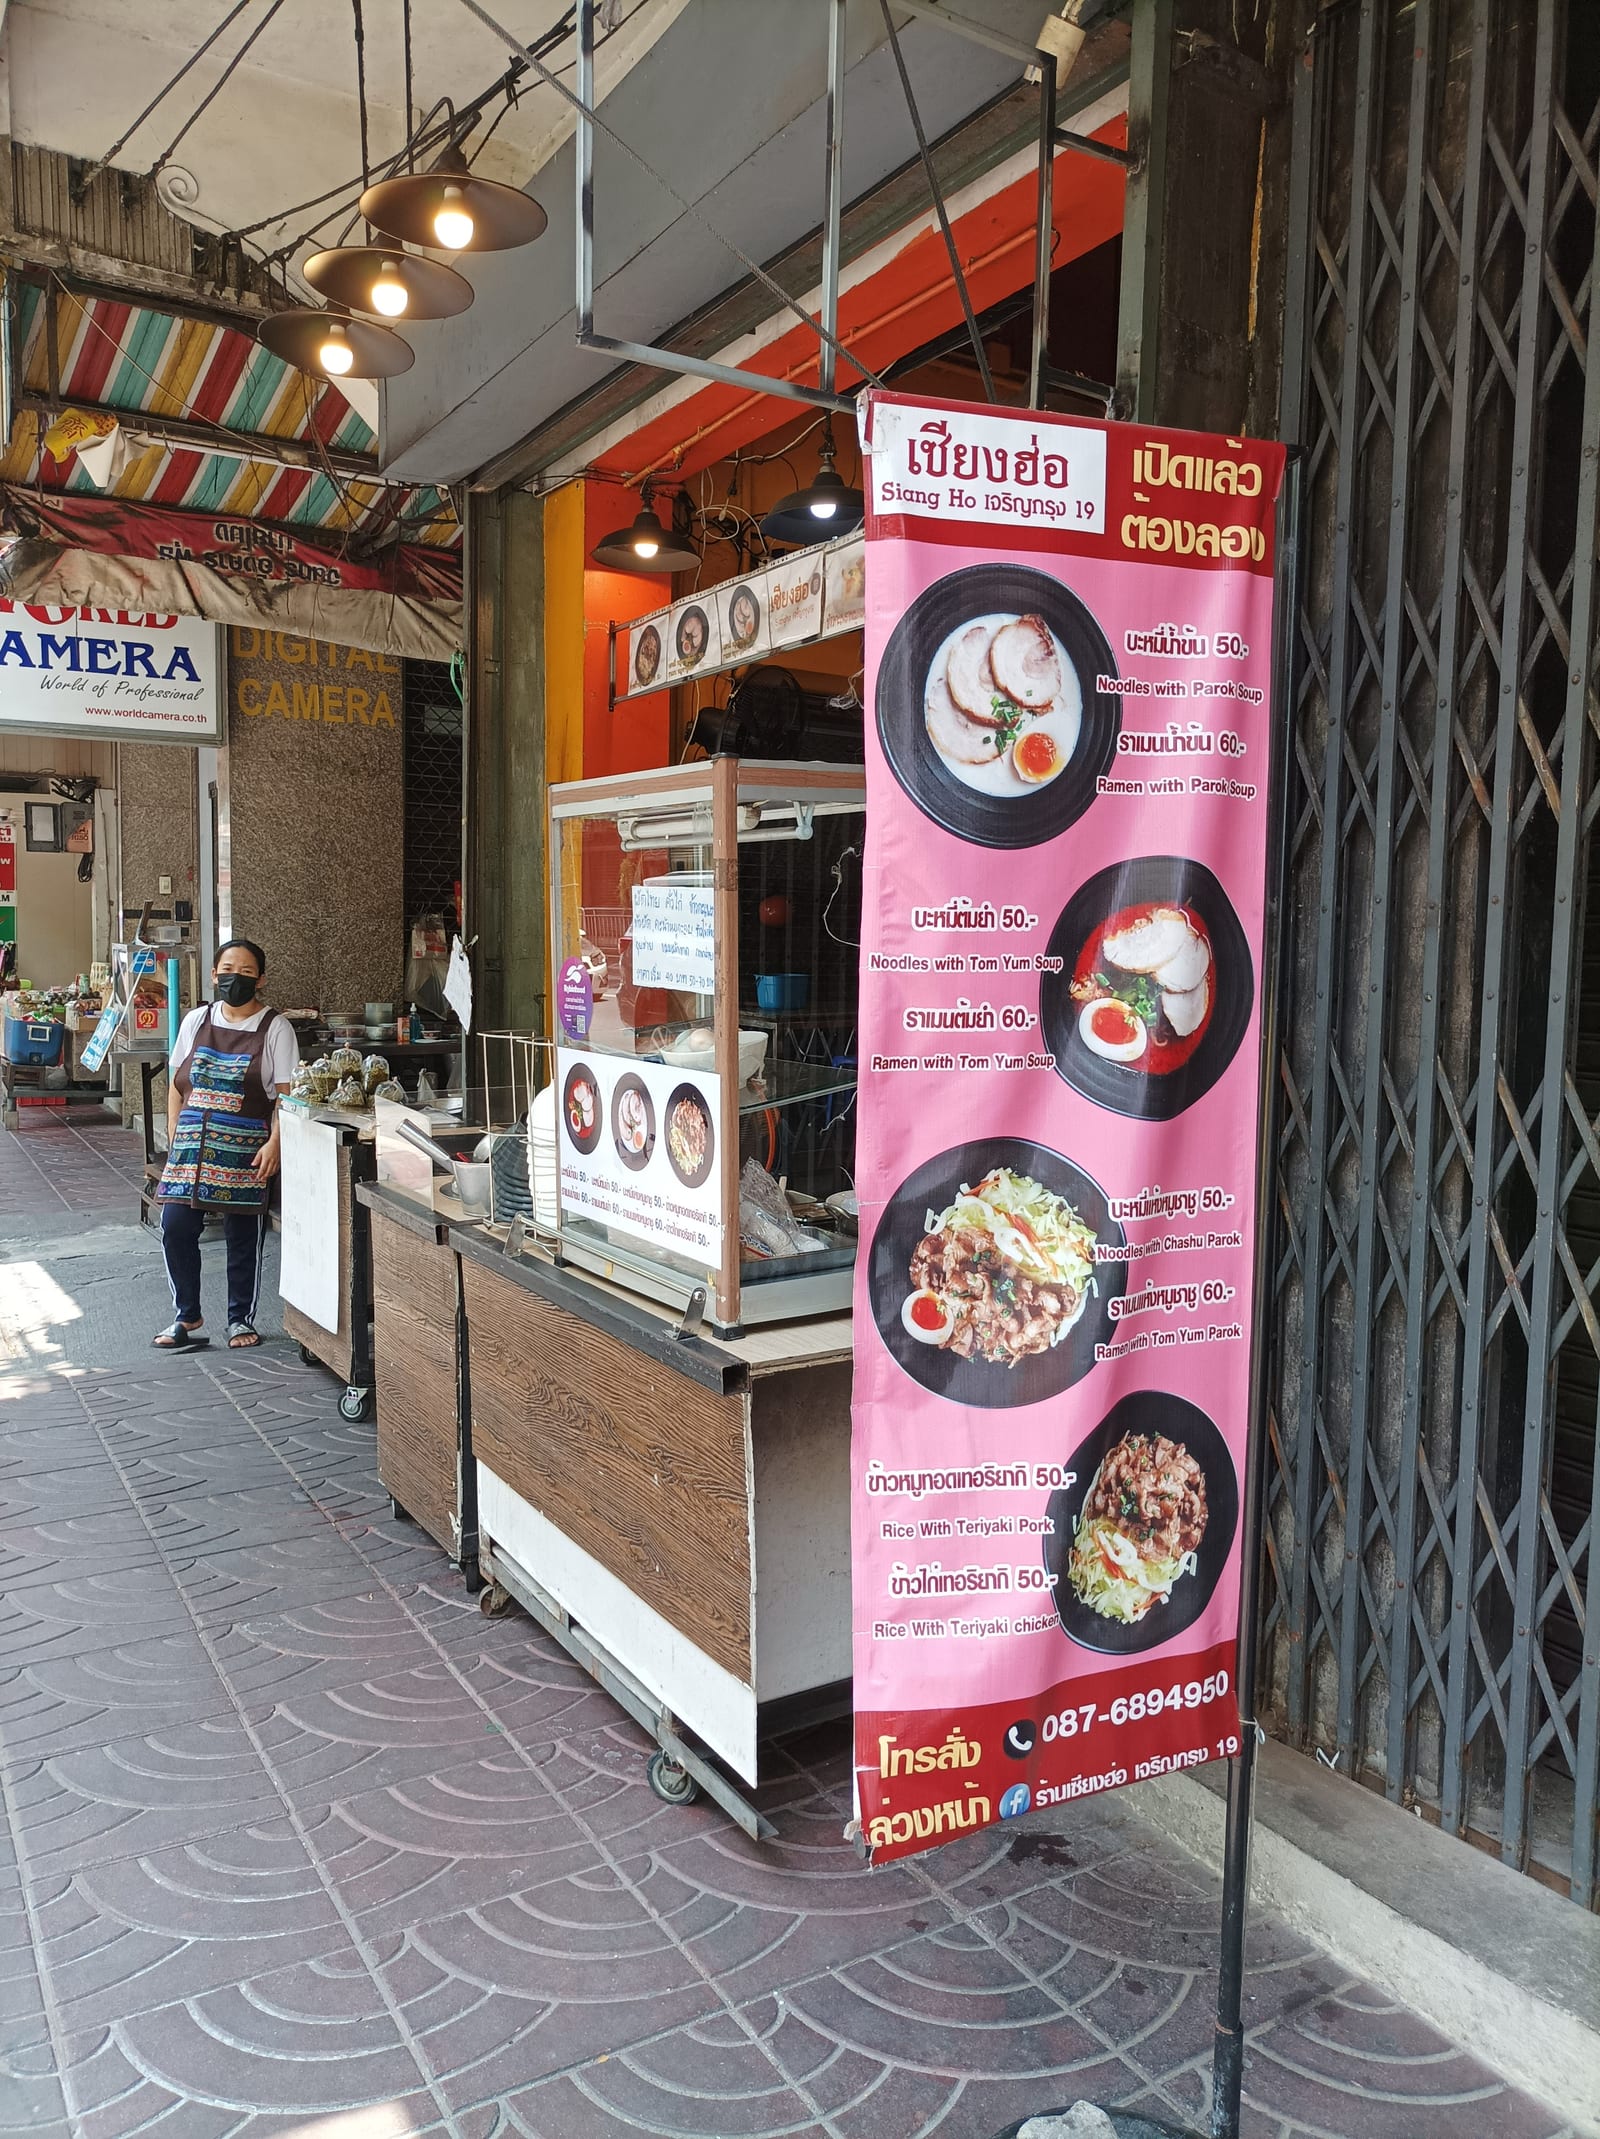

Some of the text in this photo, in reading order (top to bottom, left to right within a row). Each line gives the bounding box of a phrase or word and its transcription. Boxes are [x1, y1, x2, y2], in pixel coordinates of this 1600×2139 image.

[907, 420, 1069, 489] เซียงฮ่อ
[1133, 438, 1262, 497] เปิดแล้ว
[881, 481, 1095, 521] Siang Ho เจริญกรุง 19
[1121, 492, 1265, 562] ต้องลอง
[1127, 625, 1248, 657] บะหมี่น้ำข้น 50.-
[40, 674, 205, 702] World of Professional
[237, 678, 395, 728] CAMERA
[1097, 677, 1263, 704] Noodles with Parok Soup
[85, 706, 207, 724] www.worldcamera.co.th
[1119, 725, 1245, 755] ราเมนน้ำข้น 60.-
[1097, 777, 1255, 799] Ramen with Parok Soup
[914, 900, 1036, 928] บะหมี่ต้มยำ 50.-
[870, 955, 1062, 972] Noodles with Tom Yum Soup
[906, 1000, 1035, 1029] ราเมนต้มยำ 60.-
[872, 1053, 1054, 1070] Ramen with Tom Yum Soup
[1202, 1189, 1233, 1208] 50.-
[1097, 1232, 1240, 1260] Noodles with Chashu Parok
[1203, 1282, 1233, 1300] 60.-
[1096, 1324, 1240, 1359] Ramen with Tom Yum Parok
[868, 1463, 1074, 1498] ข้าวหมูทอดเทอริยากิ 50.-
[882, 1518, 1053, 1538] Rice With Teriyaki Pork
[892, 1565, 1057, 1595] ข้าวไก่เทอริยากิ 50.-
[874, 1613, 1060, 1638] Rice With Teriyaki chicken
[1041, 1669, 1230, 1743] 087-6894950
[878, 1726, 982, 1779] โทรสั่ง
[1035, 1761, 1128, 1808] ร้านเซียงฮ่อ
[1216, 1735, 1239, 1757] 19
[869, 1780, 991, 1848] ล่วงหน้า
